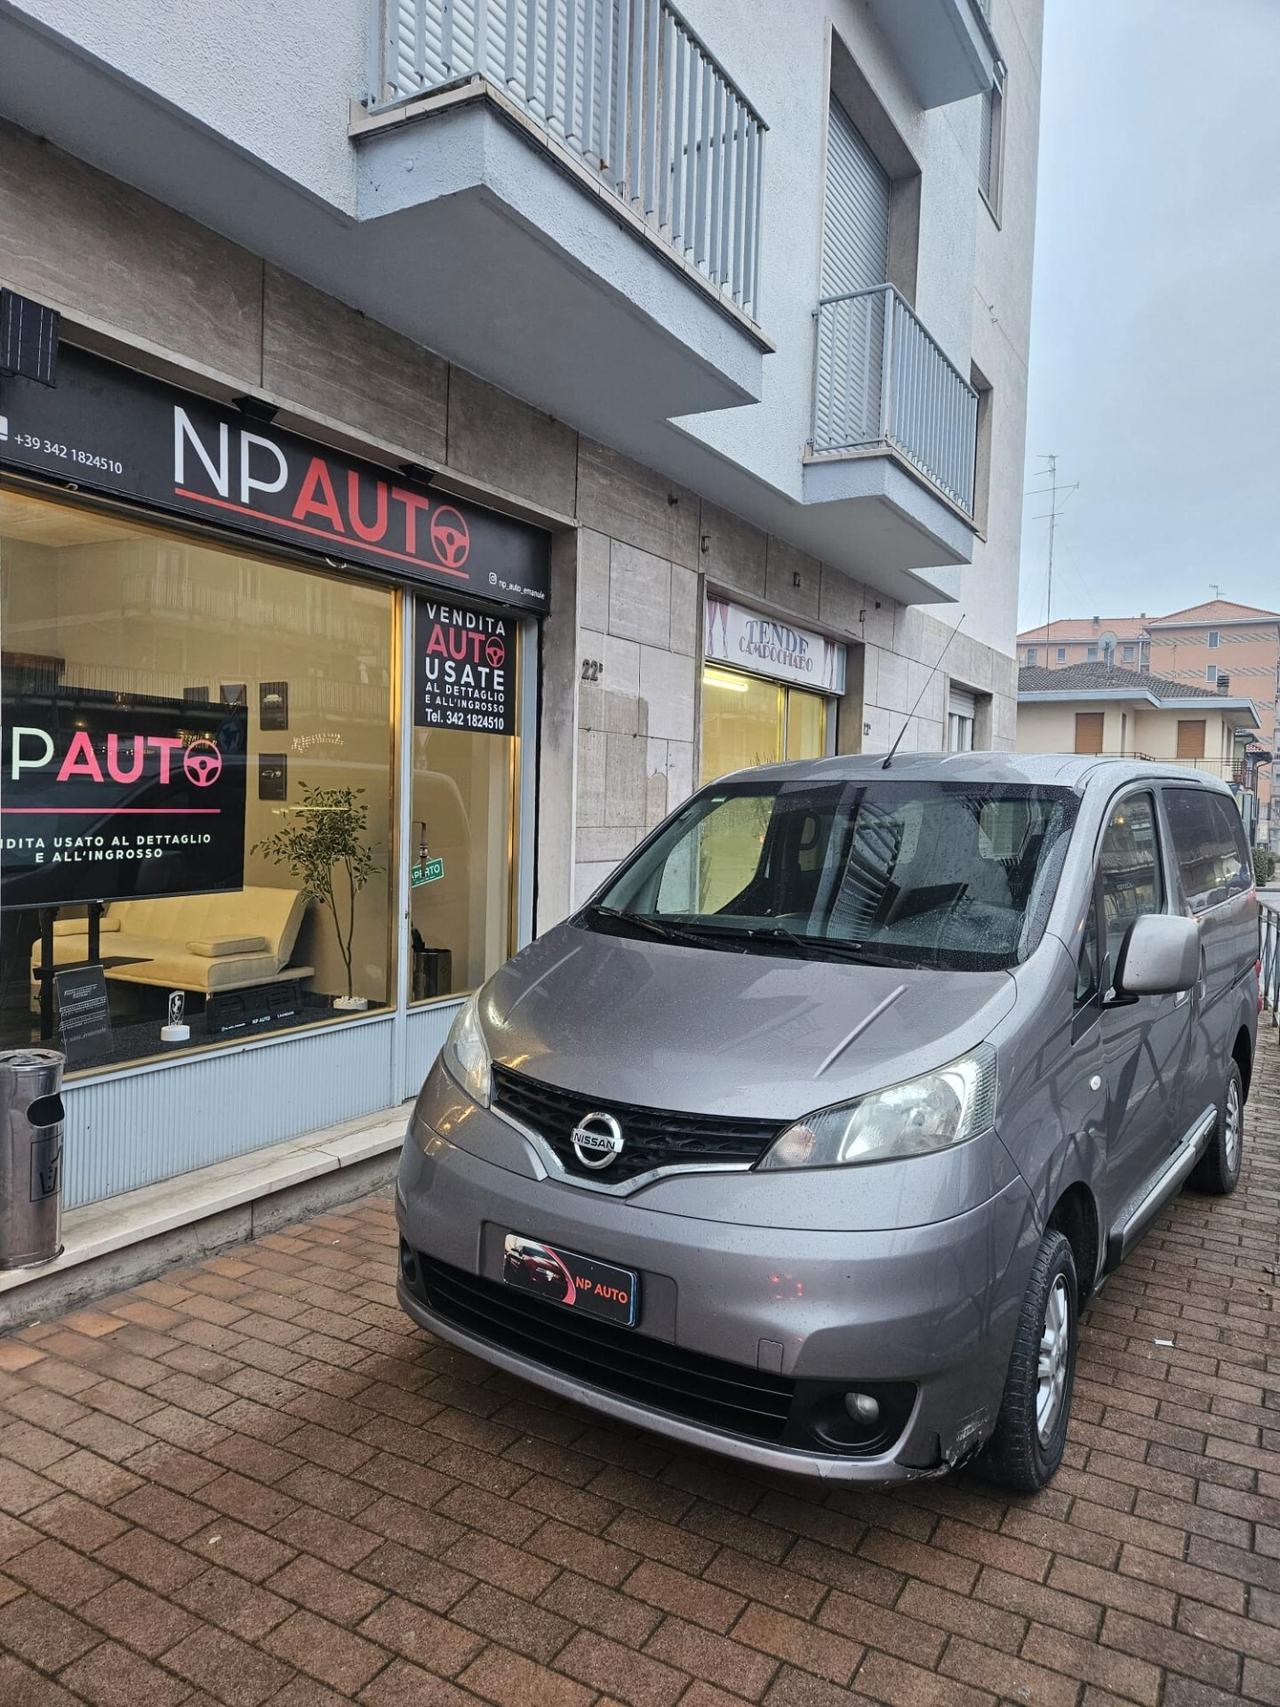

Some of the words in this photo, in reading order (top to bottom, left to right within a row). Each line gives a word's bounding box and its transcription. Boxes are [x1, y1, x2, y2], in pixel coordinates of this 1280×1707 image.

[14, 433, 41, 450] +39
[43, 440, 67, 458] 342
[71, 449, 123, 474] 1824510
[426, 602, 506, 637] VENDITA
[746, 620, 809, 655] TENDE
[425, 656, 505, 691] USATE
[425, 681, 440, 693] AL
[445, 684, 505, 702] DETTAGLIO
[425, 694, 431, 704] E
[435, 695, 505, 714] ALL'INGROSSO
[425, 708, 443, 724] Tel.
[446, 711, 464, 726] 342
[466, 713, 504, 730] 1824510
[53, 836, 104, 848] USATO
[111, 835, 130, 846] AL
[136, 833, 212, 846] DETTAGLIO
[35, 852, 45, 863] E
[52, 848, 163, 862] ALL'INGROSSO
[573, 1131, 616, 1150] NISSAN
[575, 1276, 592, 1291] NP
[594, 1283, 629, 1304] AUTO
